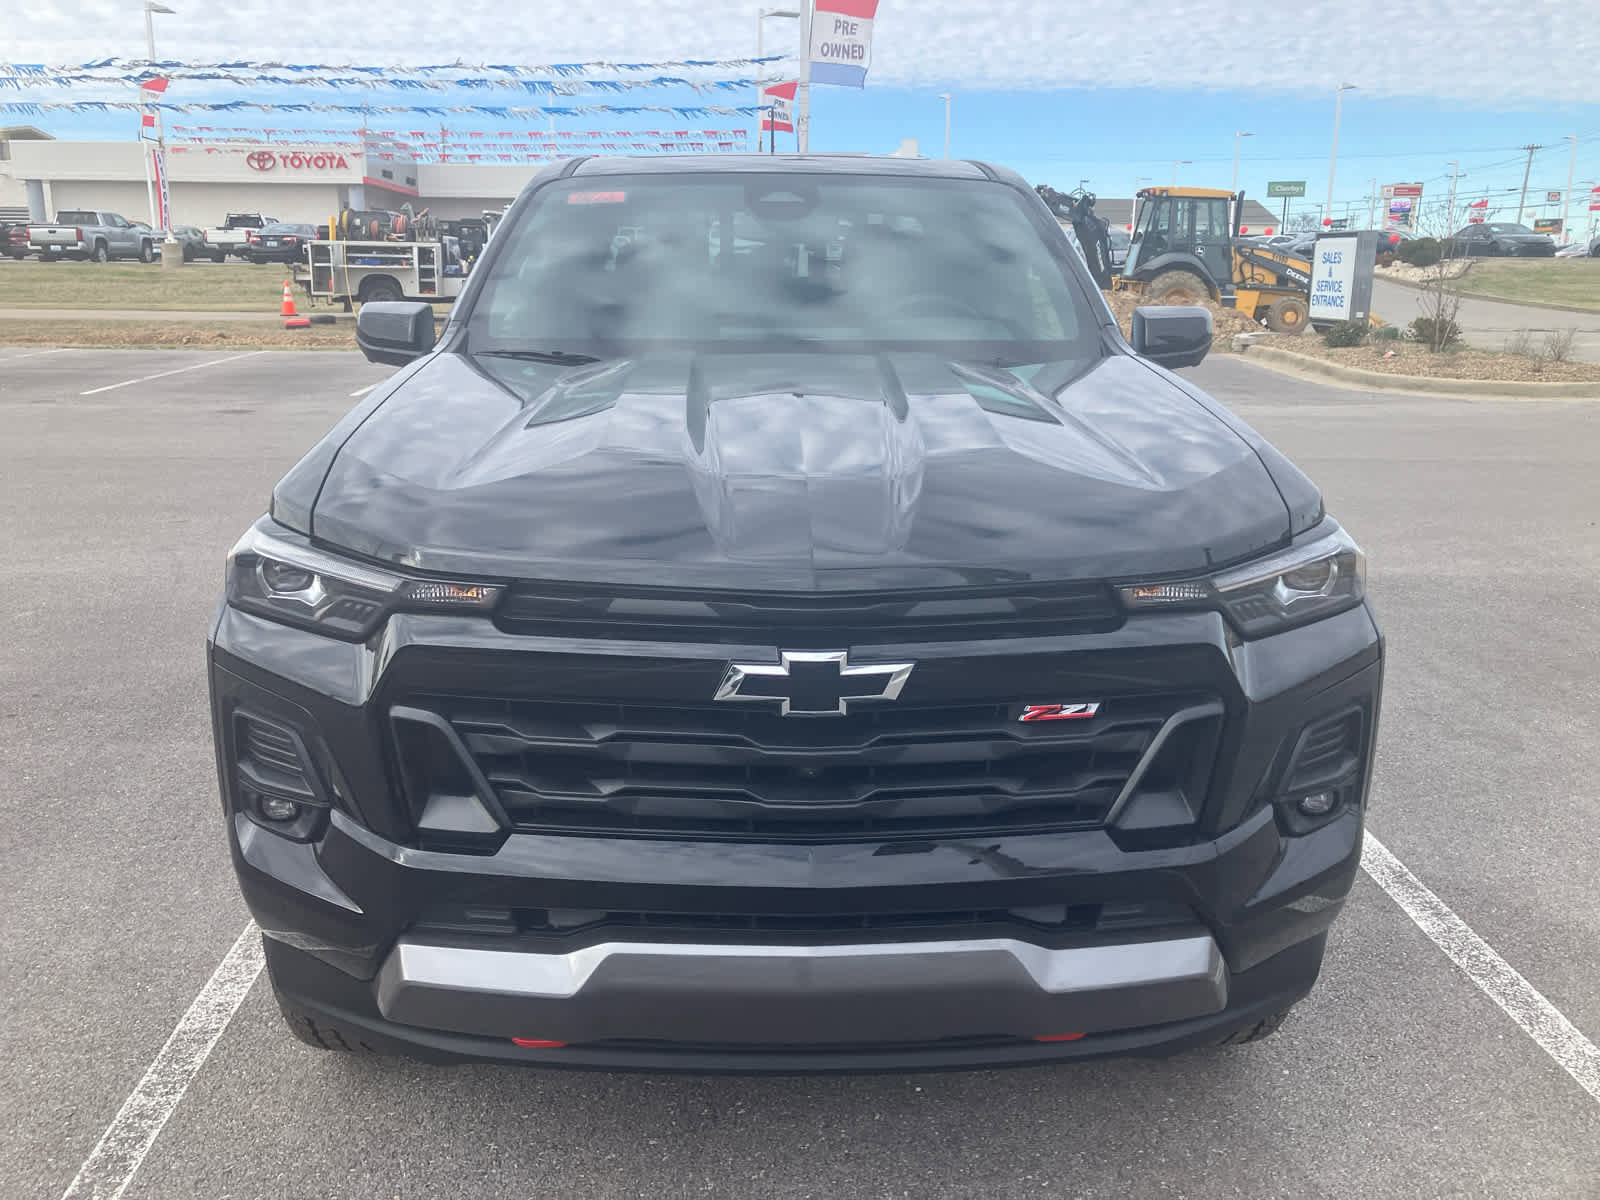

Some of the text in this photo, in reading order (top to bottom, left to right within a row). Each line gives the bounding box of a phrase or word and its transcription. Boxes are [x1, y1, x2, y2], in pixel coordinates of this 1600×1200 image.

[834, 20, 858, 36] PRE
[820, 42, 865, 60] OWNED
[279, 154, 349, 169] TOYOTA
[1321, 251, 1343, 264] SALES
[1315, 280, 1343, 293] SERVICE
[1311, 294, 1345, 308] ENTRANCE
